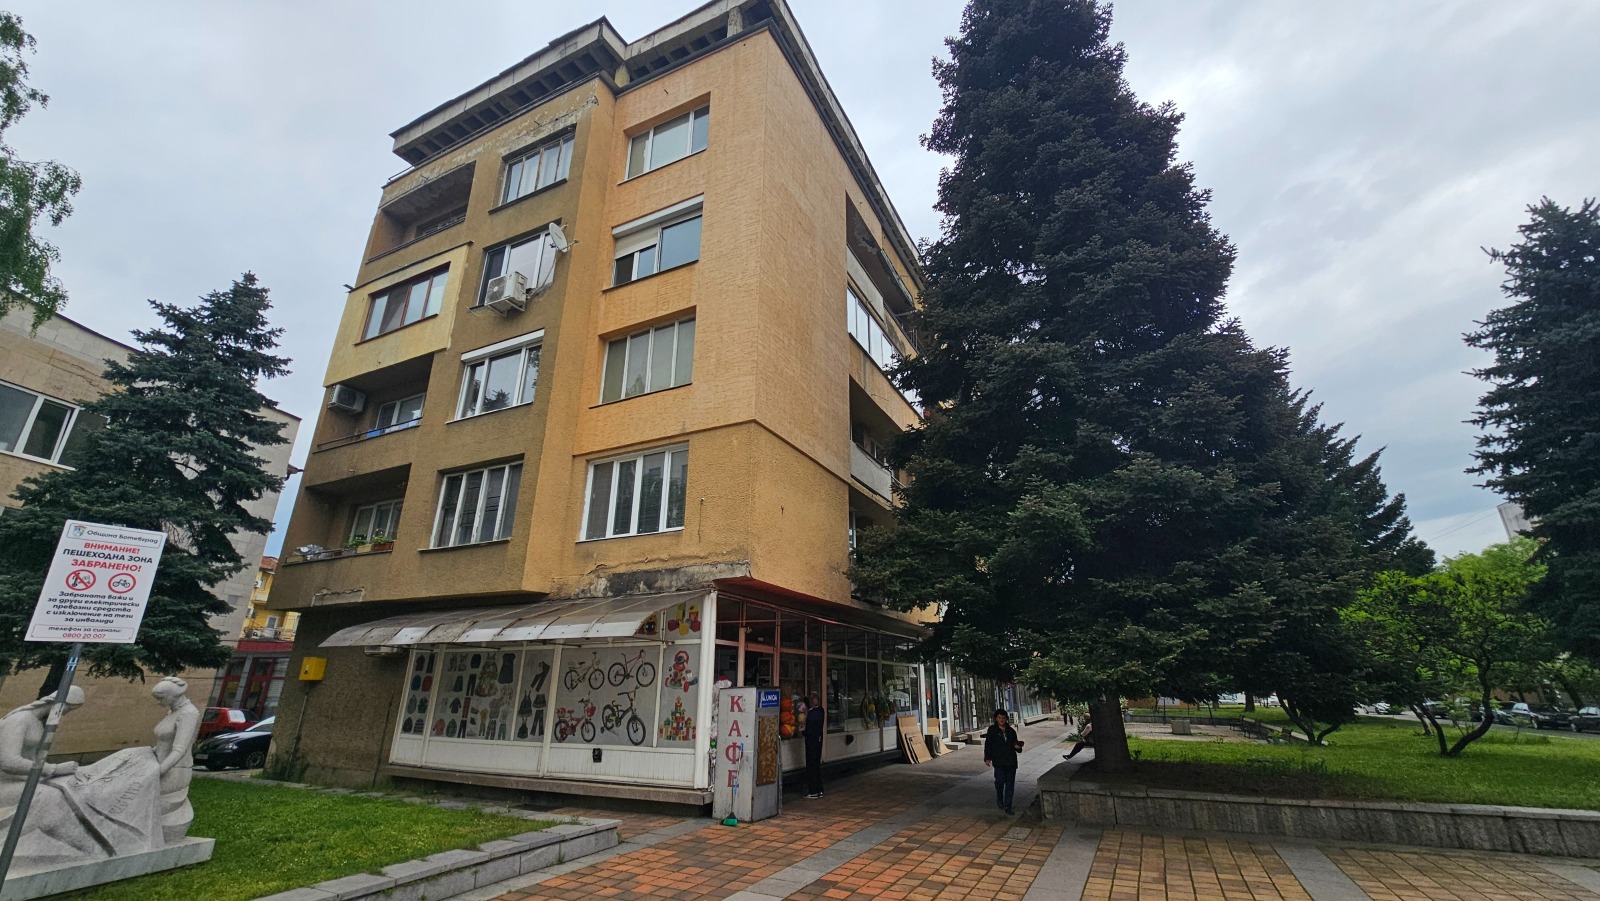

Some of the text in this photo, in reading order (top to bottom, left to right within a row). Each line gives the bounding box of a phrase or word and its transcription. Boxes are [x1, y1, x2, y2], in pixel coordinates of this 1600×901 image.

[87, 530, 158, 544] Община Ботевград
[84, 542, 140, 554] ВНИМАНИЕ!
[62, 548, 153, 563] ПЕШЕХОДНА ЗОНА
[71, 559, 142, 572] ЗАБРАНЕНО!
[59, 591, 106, 600] Забраната
[84, 599, 140, 607] електрически
[725, 696, 744, 787] КАФЕ
